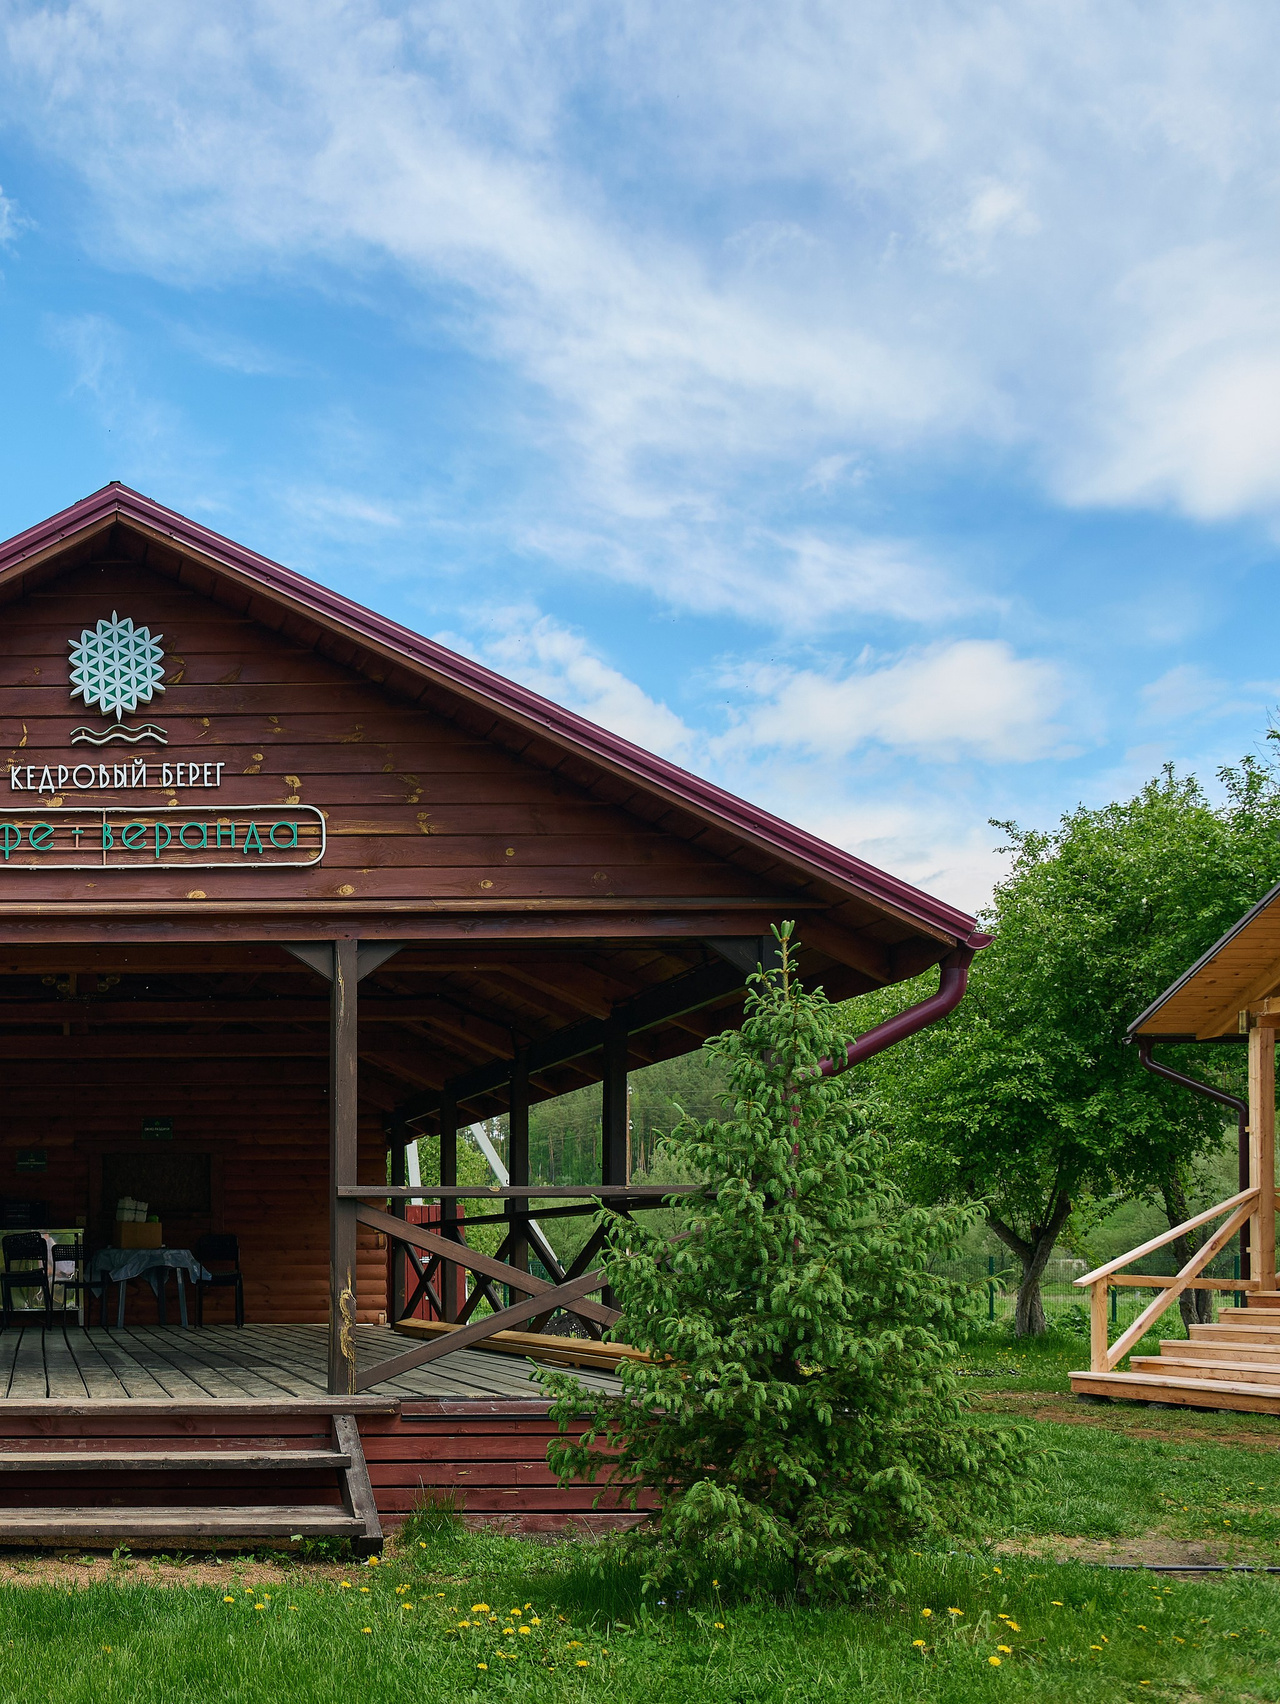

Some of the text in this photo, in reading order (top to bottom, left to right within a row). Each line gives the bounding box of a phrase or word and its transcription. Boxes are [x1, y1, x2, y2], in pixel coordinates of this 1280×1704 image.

[10, 758, 226, 794] КЕДРОВЫЙ БЕРЕГ
[102, 821, 298, 859] веранда
